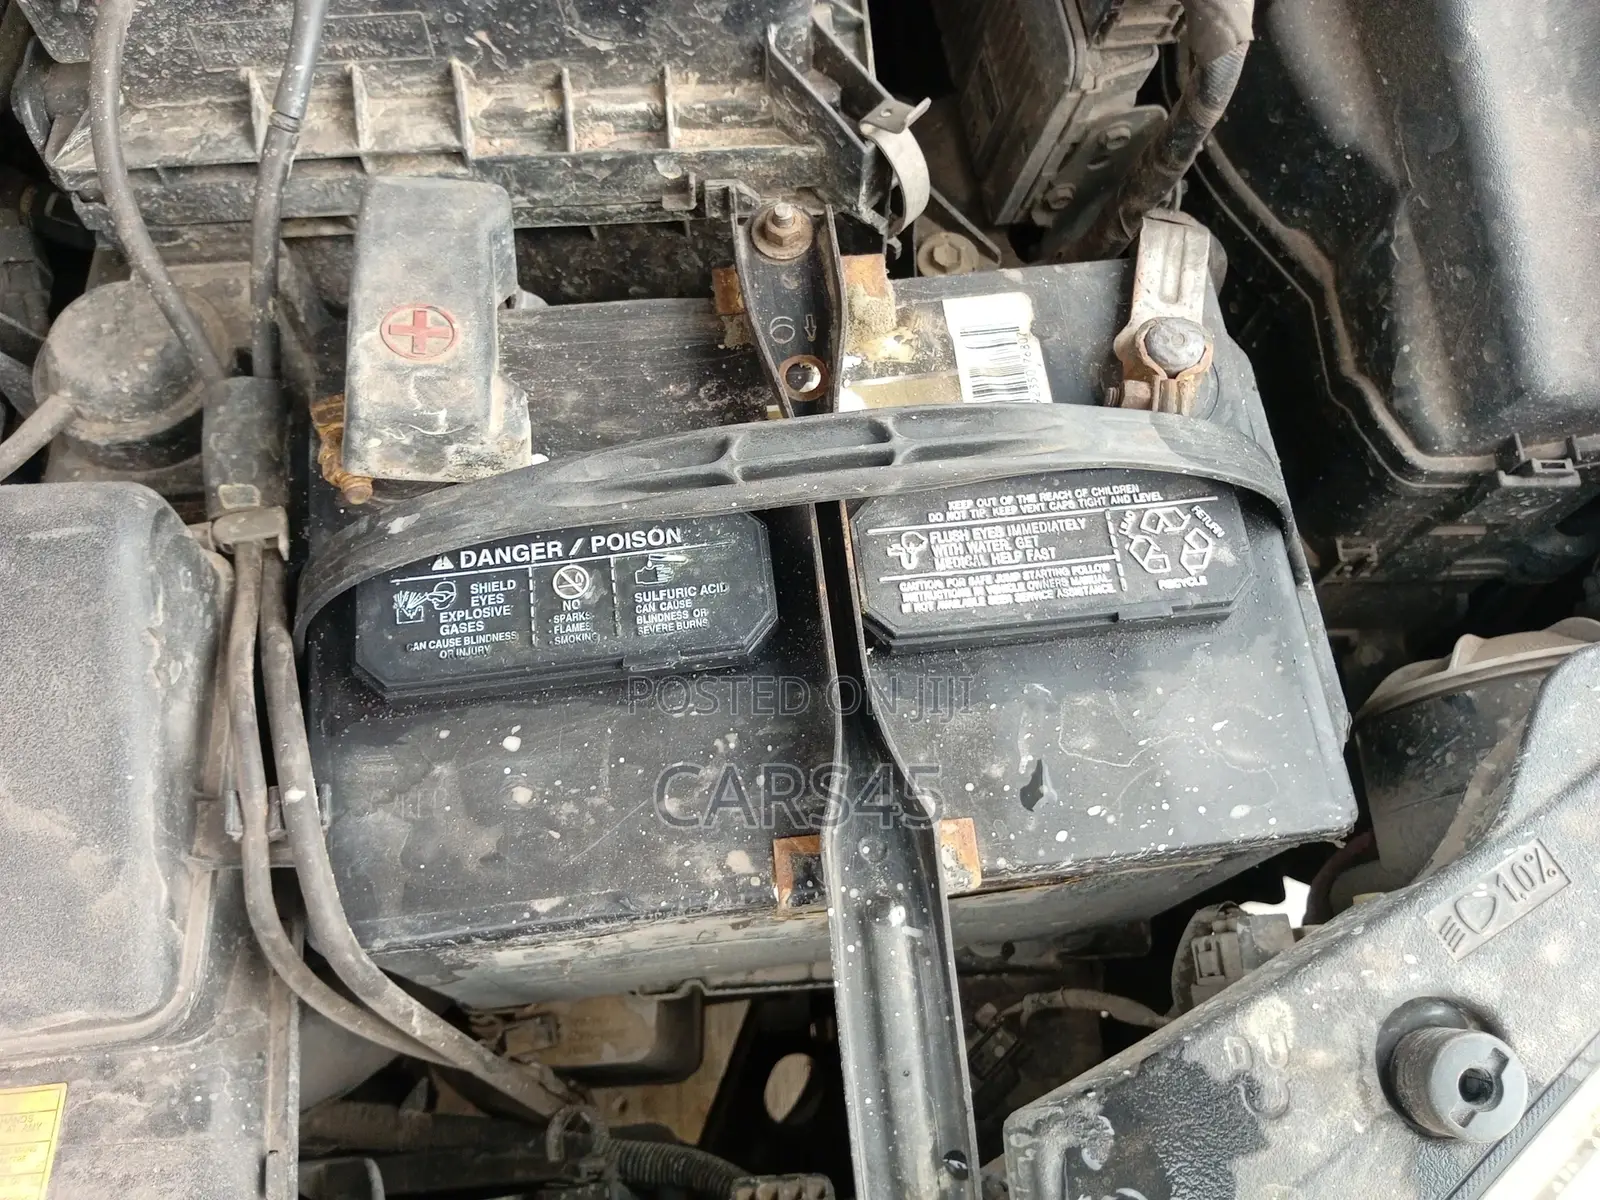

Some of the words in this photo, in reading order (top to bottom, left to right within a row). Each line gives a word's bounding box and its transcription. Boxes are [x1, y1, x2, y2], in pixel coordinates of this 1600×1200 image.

[948, 499, 973, 511] KEEP
[977, 496, 997, 508] OUT
[1000, 495, 1014, 506] OF
[1017, 492, 1036, 504] THE
[1039, 489, 1072, 503] REACH
[1075, 488, 1089, 498] OF
[1091, 484, 1139, 497] CHILDREN
[928, 512, 944, 523] DO
[946, 510, 967, 522] NOT
[992, 505, 1017, 518] KEEP
[1021, 502, 1046, 515] VENT
[1049, 499, 1076, 512] CAPS
[1078, 497, 1106, 510] TIGHT
[1110, 494, 1131, 505] AND
[1134, 491, 1163, 503] LEVEL
[929, 529, 970, 544] FLUSH
[972, 525, 1004, 540] EYES
[1007, 517, 1086, 537] IMMEDIATELY
[1191, 505, 1225, 538] RETURN
[460, 541, 563, 569] DANGER
[591, 527, 682, 553] POISON
[930, 542, 964, 558] WITH
[1015, 535, 1039, 549] GET
[934, 554, 988, 571] MEDICAL
[990, 551, 1022, 565] HELP
[1026, 547, 1056, 562] FAST
[1022, 566, 1070, 581] STARTING
[1071, 562, 1111, 576] FOLLOW
[470, 580, 516, 594] SHIELD
[634, 586, 697, 603] SULFURIC
[700, 582, 730, 596] ACID
[1027, 577, 1069, 591] OWNERS
[471, 593, 504, 607] EYES
[563, 601, 580, 611] NO
[635, 602, 656, 614] CAN
[660, 599, 692, 611] CAUSE
[440, 605, 511, 623] EXPLOSIVE
[554, 612, 592, 624] SPARKS
[636, 609, 688, 625] BLINDNESS
[693, 608, 708, 618] OR
[440, 621, 485, 636] GASES
[554, 622, 592, 634] FLAMES
[637, 621, 675, 636] SEVERE
[677, 618, 709, 631] BURNS
[406, 641, 426, 651] CAN
[428, 638, 462, 649] CAUSE
[464, 631, 519, 646] BLINDNESS
[554, 632, 600, 645] SMOKING
[440, 649, 456, 659] OR
[456, 645, 490, 656] INJURY
